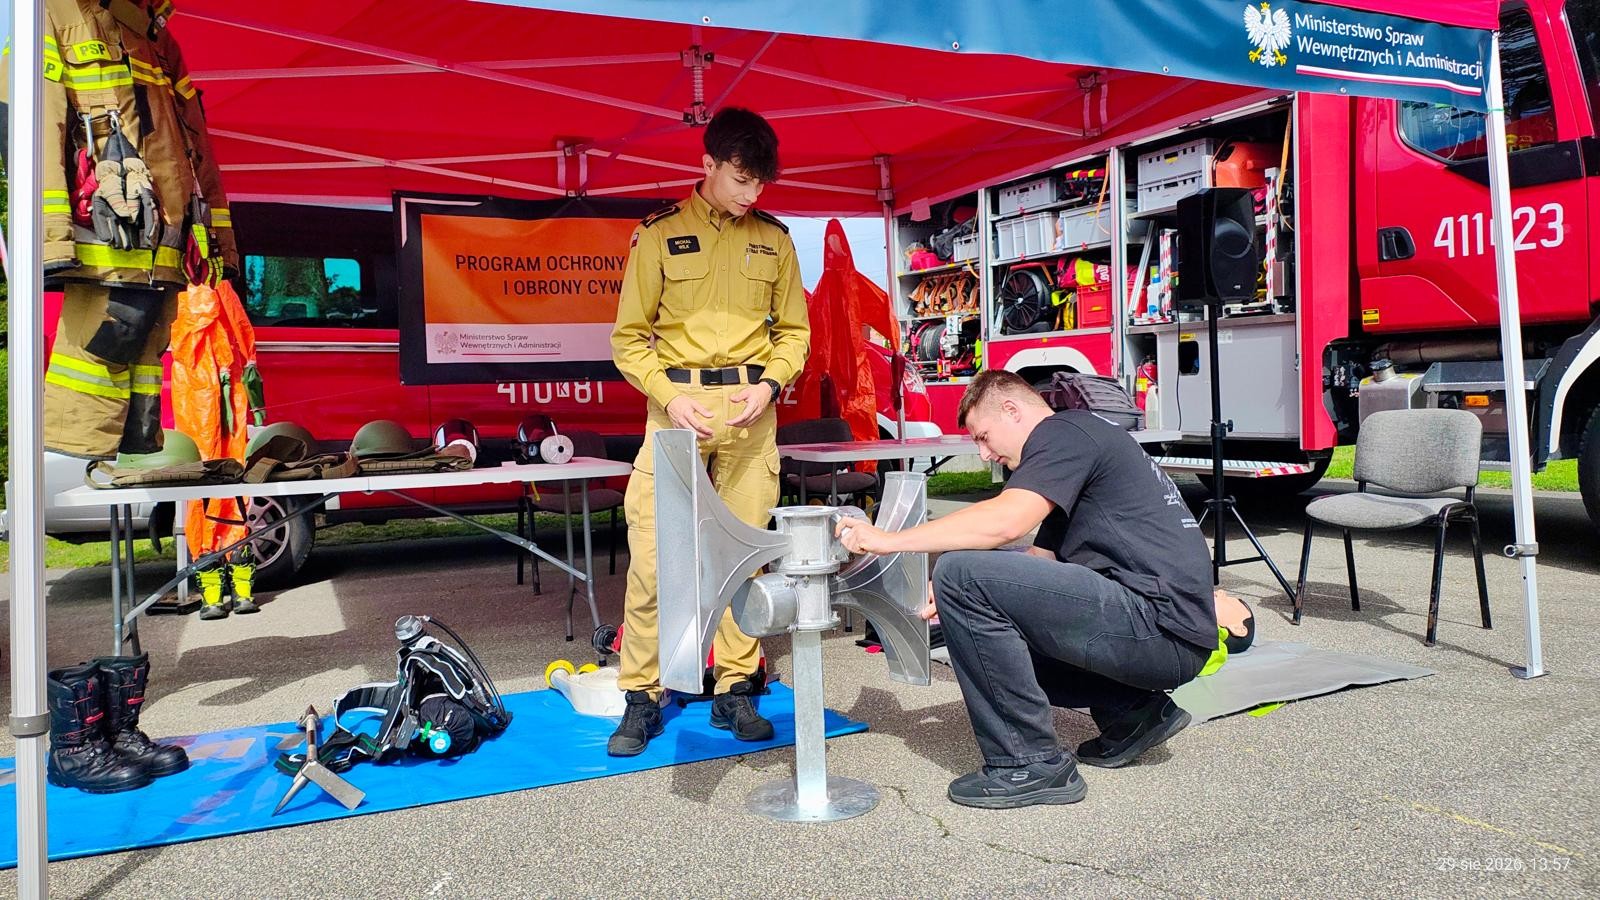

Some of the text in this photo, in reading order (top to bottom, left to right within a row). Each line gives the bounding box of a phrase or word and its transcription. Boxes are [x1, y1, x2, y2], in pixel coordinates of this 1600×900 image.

[1295, 12, 1424, 47] Ministerstwo Spraw
[79, 43, 105, 56] PSP
[1296, 35, 1483, 80] Wewnętrznych i Administracji
[1434, 203, 1564, 258] 41123
[455, 255, 626, 271] PROGRAM OCHRONY
[504, 279, 623, 295] I OBRONY CYW
[460, 333, 529, 342] Ministerstwo Spraw
[460, 341, 512, 350] Wewnętrznych
[518, 341, 562, 349] Administracji
